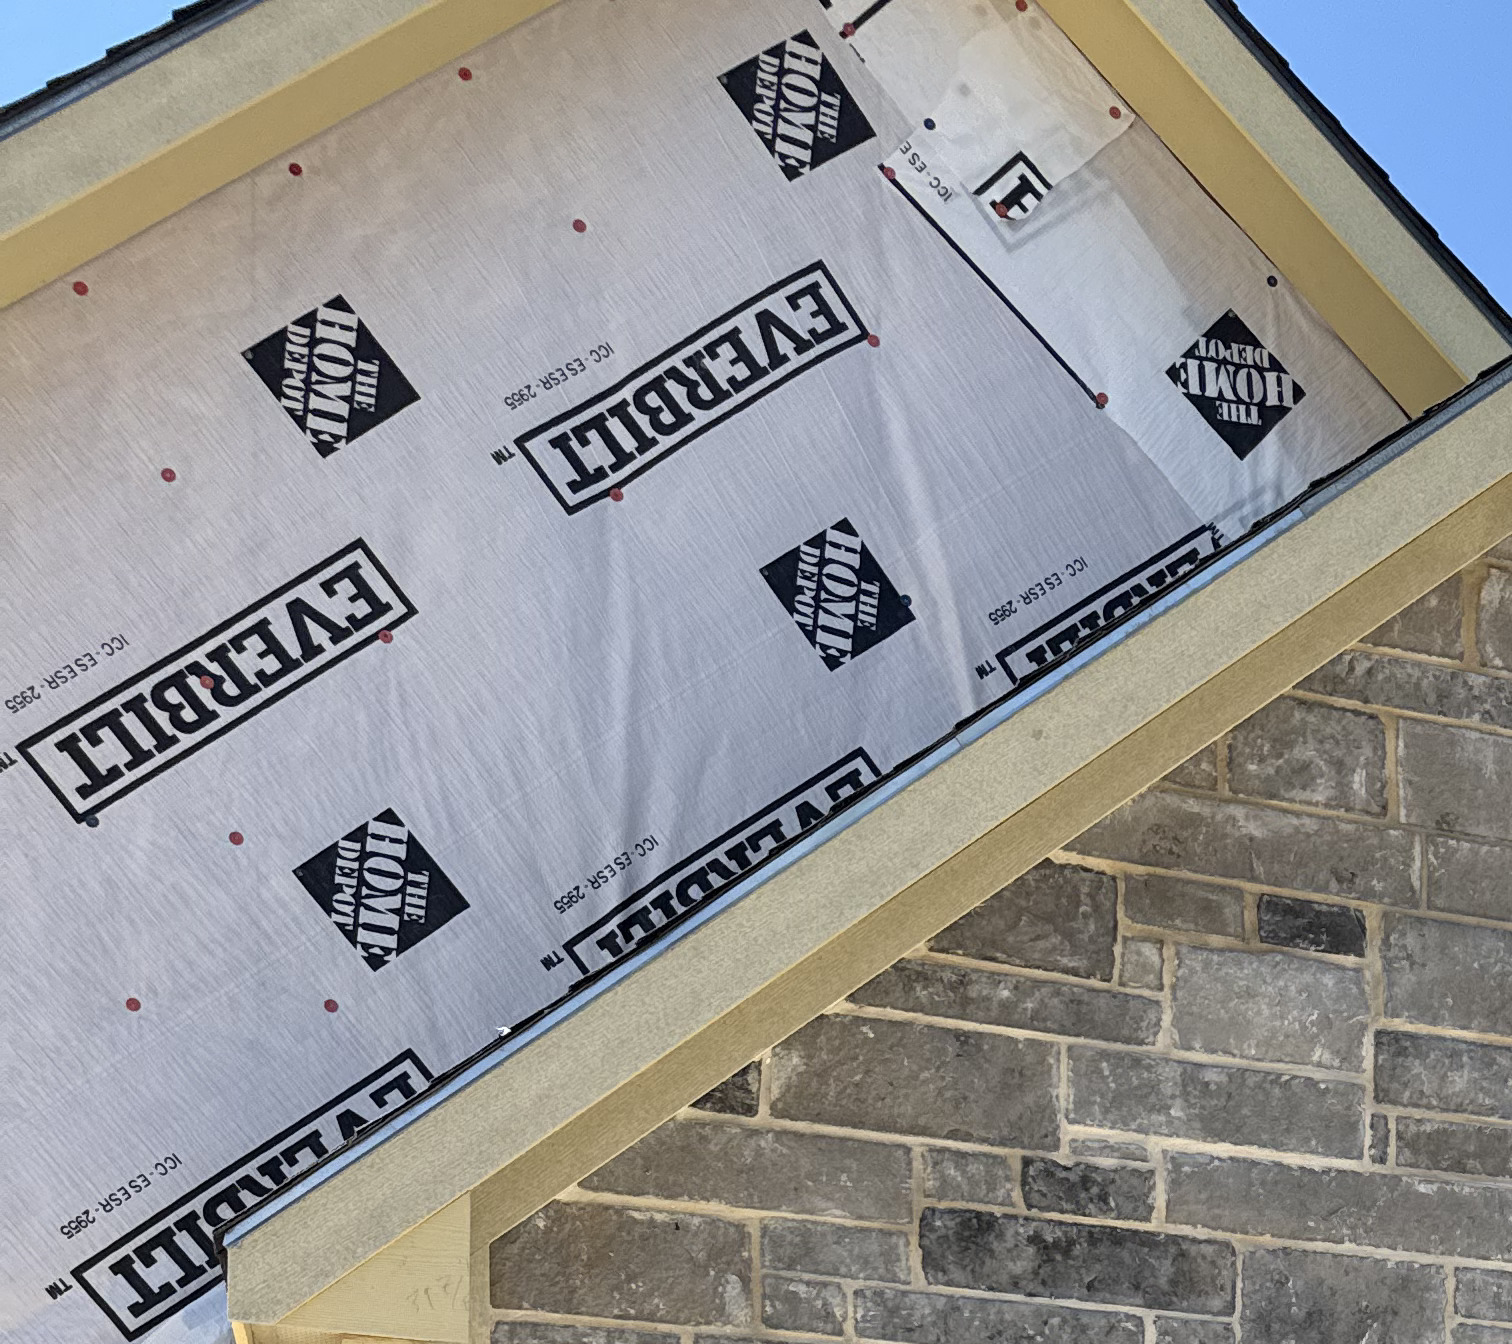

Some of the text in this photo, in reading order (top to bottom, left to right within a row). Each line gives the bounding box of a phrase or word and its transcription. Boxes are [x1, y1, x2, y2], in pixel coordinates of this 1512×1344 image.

[752, 53, 780, 140] DEPOT
[775, 38, 823, 174] HOME
[817, 91, 841, 143] THE
[281, 323, 311, 415] DEPOT
[305, 305, 358, 449] HOME
[354, 359, 379, 412] THE
[548, 281, 849, 494] EVERBILT
[1175, 358, 1294, 409] HOME
[1195, 337, 1270, 368] DEPOT
[1216, 401, 1262, 426] THE
[793, 544, 821, 630] DEPOT
[816, 527, 862, 663] HOME
[857, 580, 880, 631] THE
[54, 560, 393, 800] EVERBILT
[331, 839, 361, 930] DEPOT
[356, 819, 409, 962] HOME
[404, 870, 430, 924] THE
